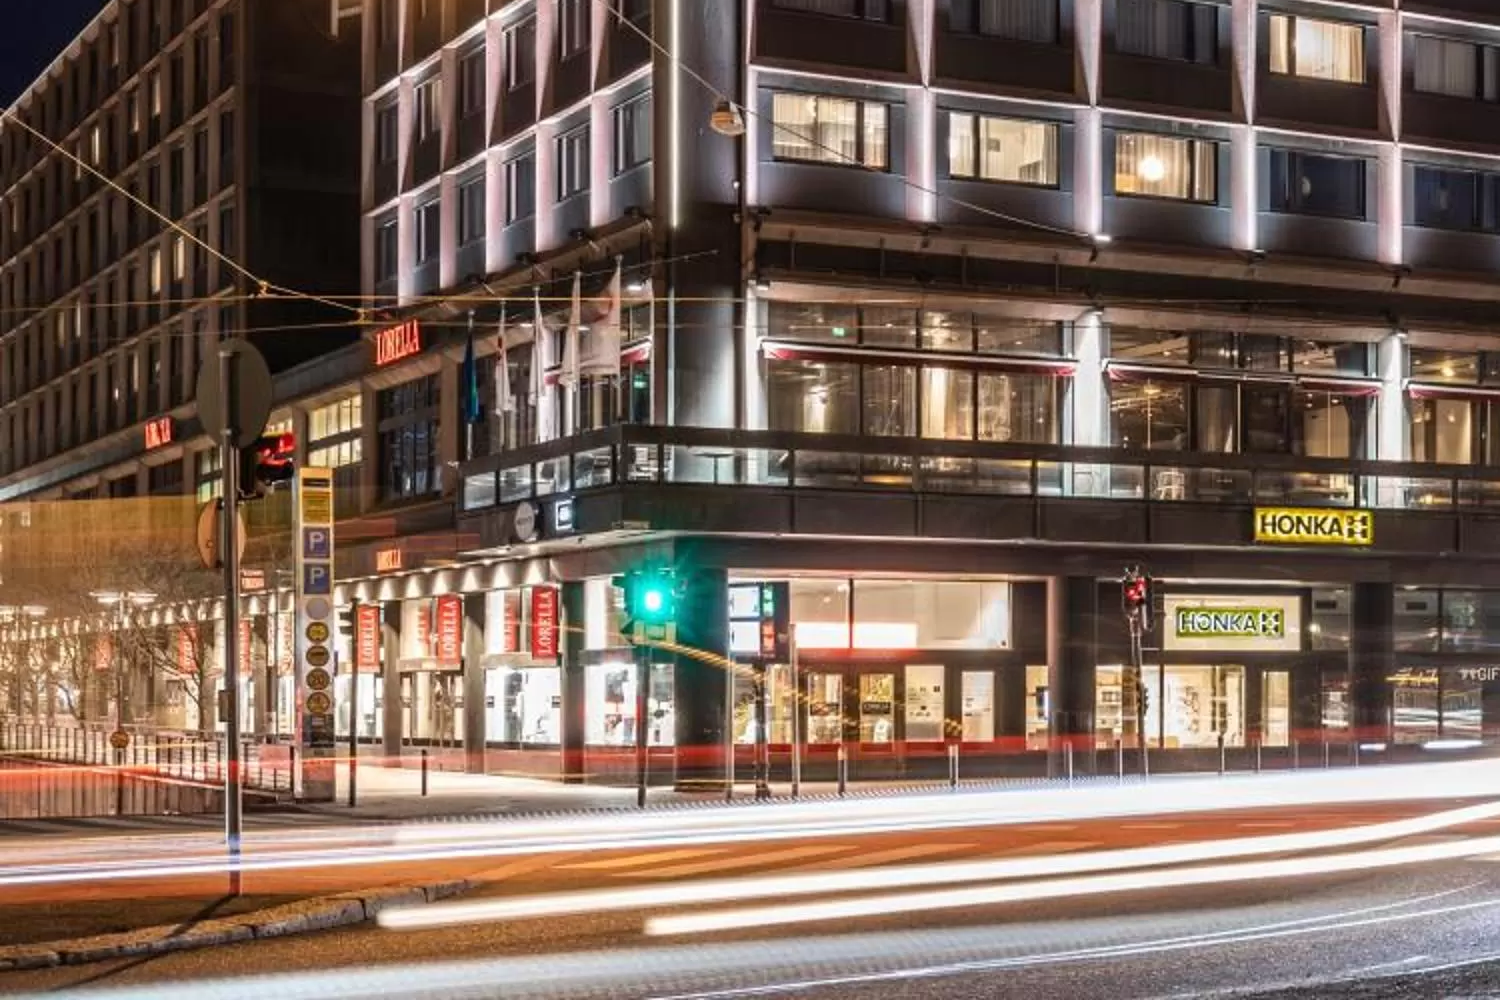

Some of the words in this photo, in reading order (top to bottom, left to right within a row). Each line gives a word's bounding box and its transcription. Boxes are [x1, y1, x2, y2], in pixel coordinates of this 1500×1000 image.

[1260, 514, 1343, 536] HONKA
[309, 532, 325, 552] P
[309, 567, 325, 587] P
[444, 599, 458, 660] LORELLA
[537, 590, 553, 656] LORELLA
[1180, 612, 1258, 633] HONKA
